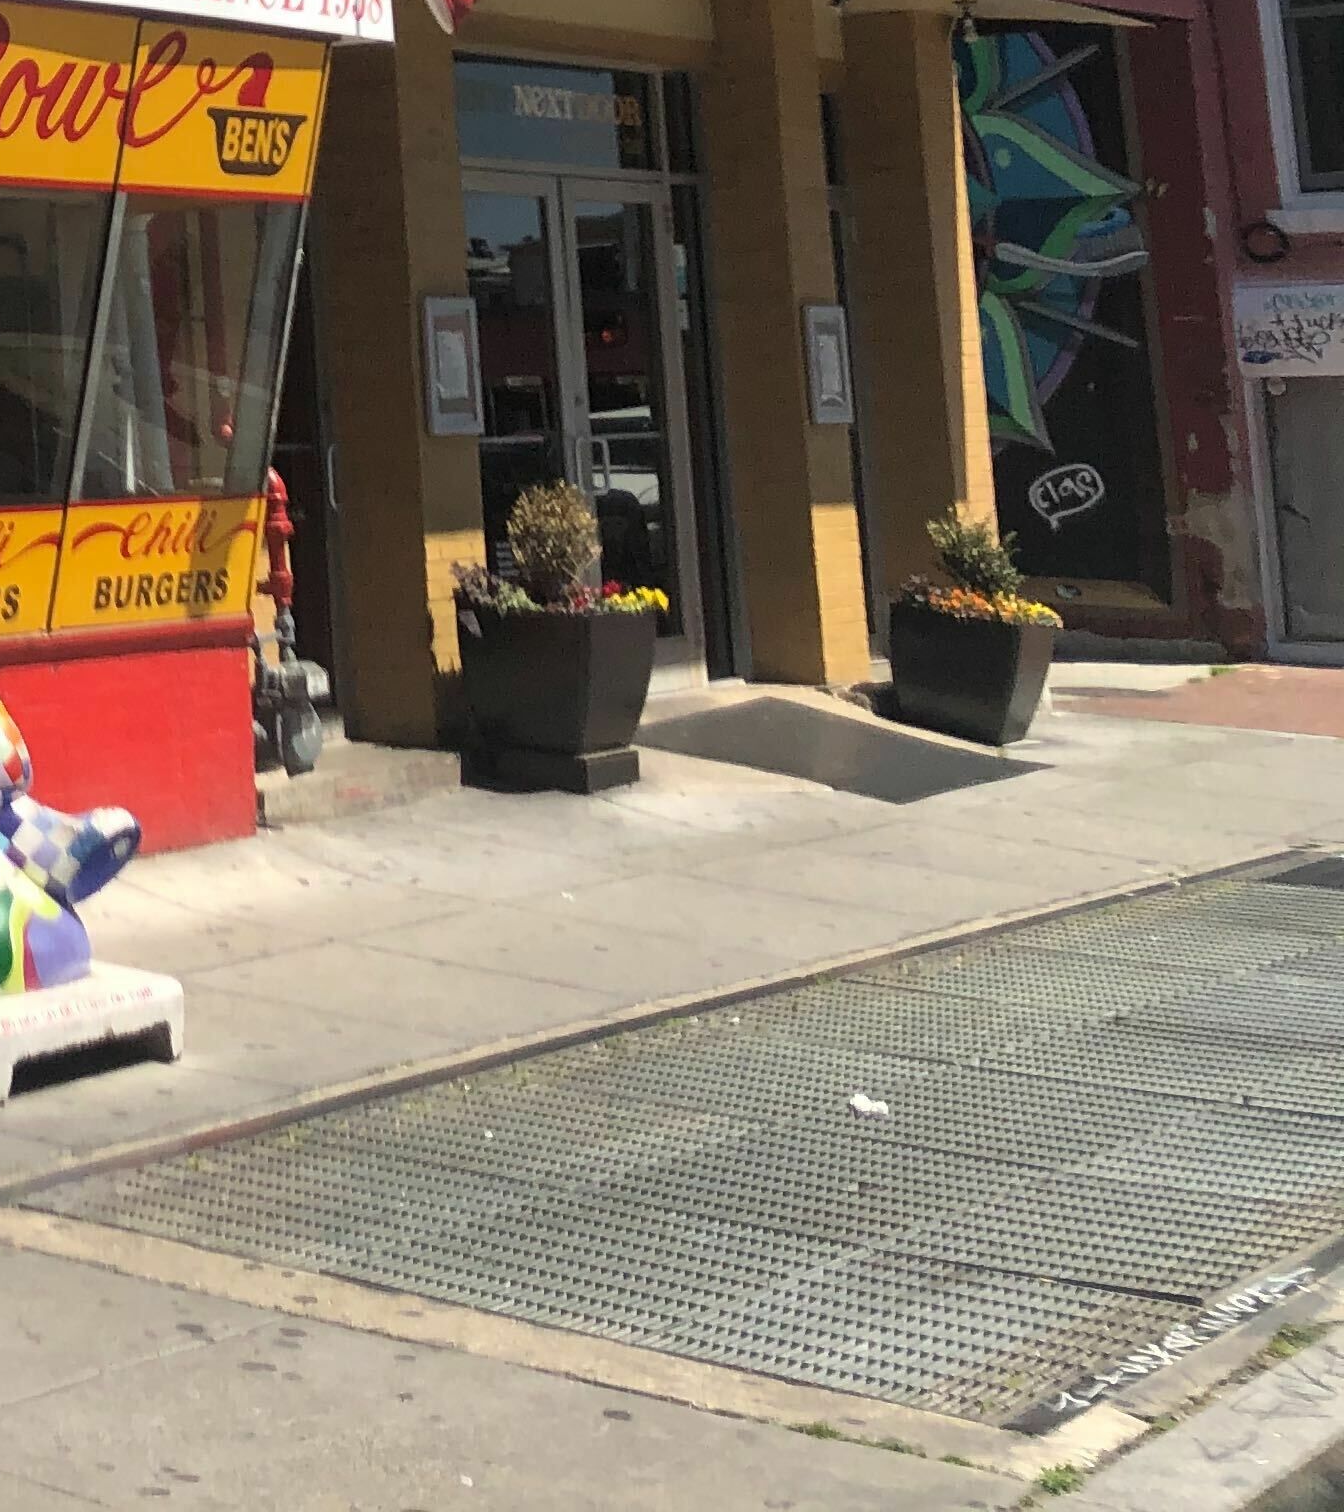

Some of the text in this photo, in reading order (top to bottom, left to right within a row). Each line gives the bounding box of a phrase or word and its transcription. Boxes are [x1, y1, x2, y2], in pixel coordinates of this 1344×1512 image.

[221, 116, 292, 167] BEN'S
[119, 510, 218, 560] Chili
[94, 567, 231, 610] BURGERS
